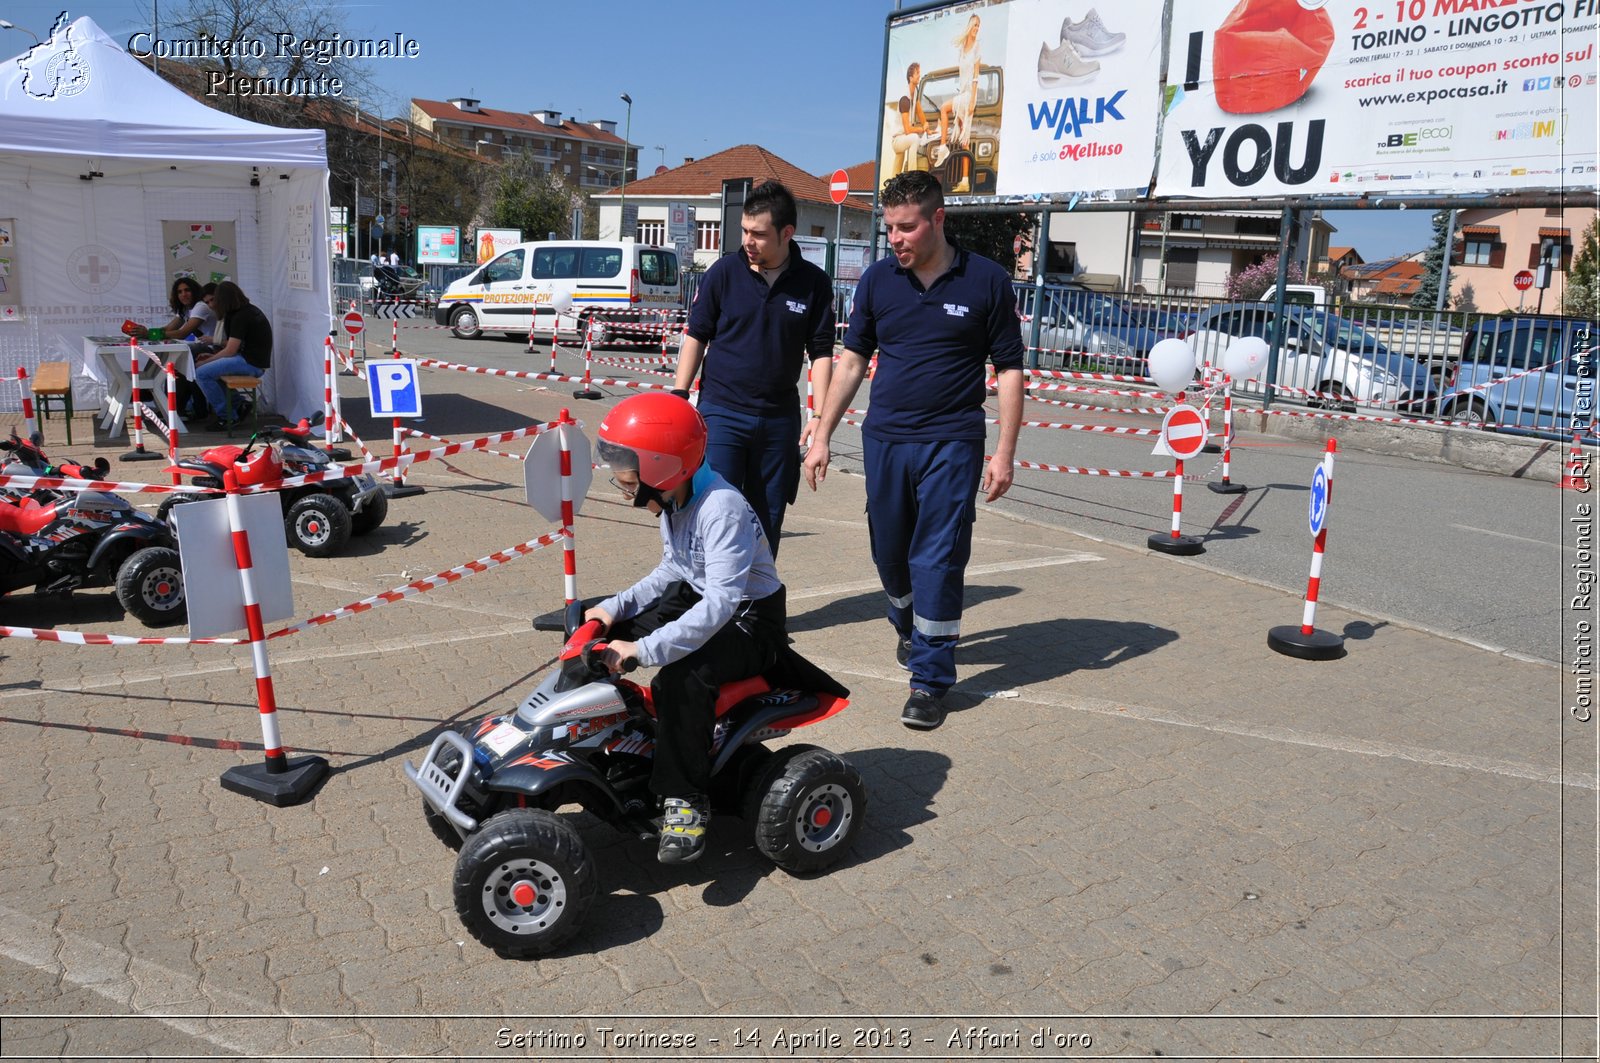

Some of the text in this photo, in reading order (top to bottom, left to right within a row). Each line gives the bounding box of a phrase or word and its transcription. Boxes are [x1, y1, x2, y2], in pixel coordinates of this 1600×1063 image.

[1351, 25, 1427, 51] TORINO
[1448, 2, 1565, 38] LINGOTTO
[1353, 7, 1368, 30] 2
[1396, 0, 1426, 22] 10
[1423, 45, 1448, 54] SABATO
[1455, 40, 1491, 49] DOMENICA
[1530, 29, 1557, 39] ULTIMA
[1344, 43, 1593, 89] scarica il tuo coupon sconto sul
[1358, 78, 1508, 107] www.expocasa.it
[1027, 89, 1128, 140] WALK
[1040, 150, 1057, 162] solo
[1059, 141, 1123, 161] Melluso
[1180, 119, 1326, 187] YOU
[1514, 276, 1533, 285] STOP
[484, 293, 535, 303] PROTEZIONE
[376, 364, 411, 411] P
